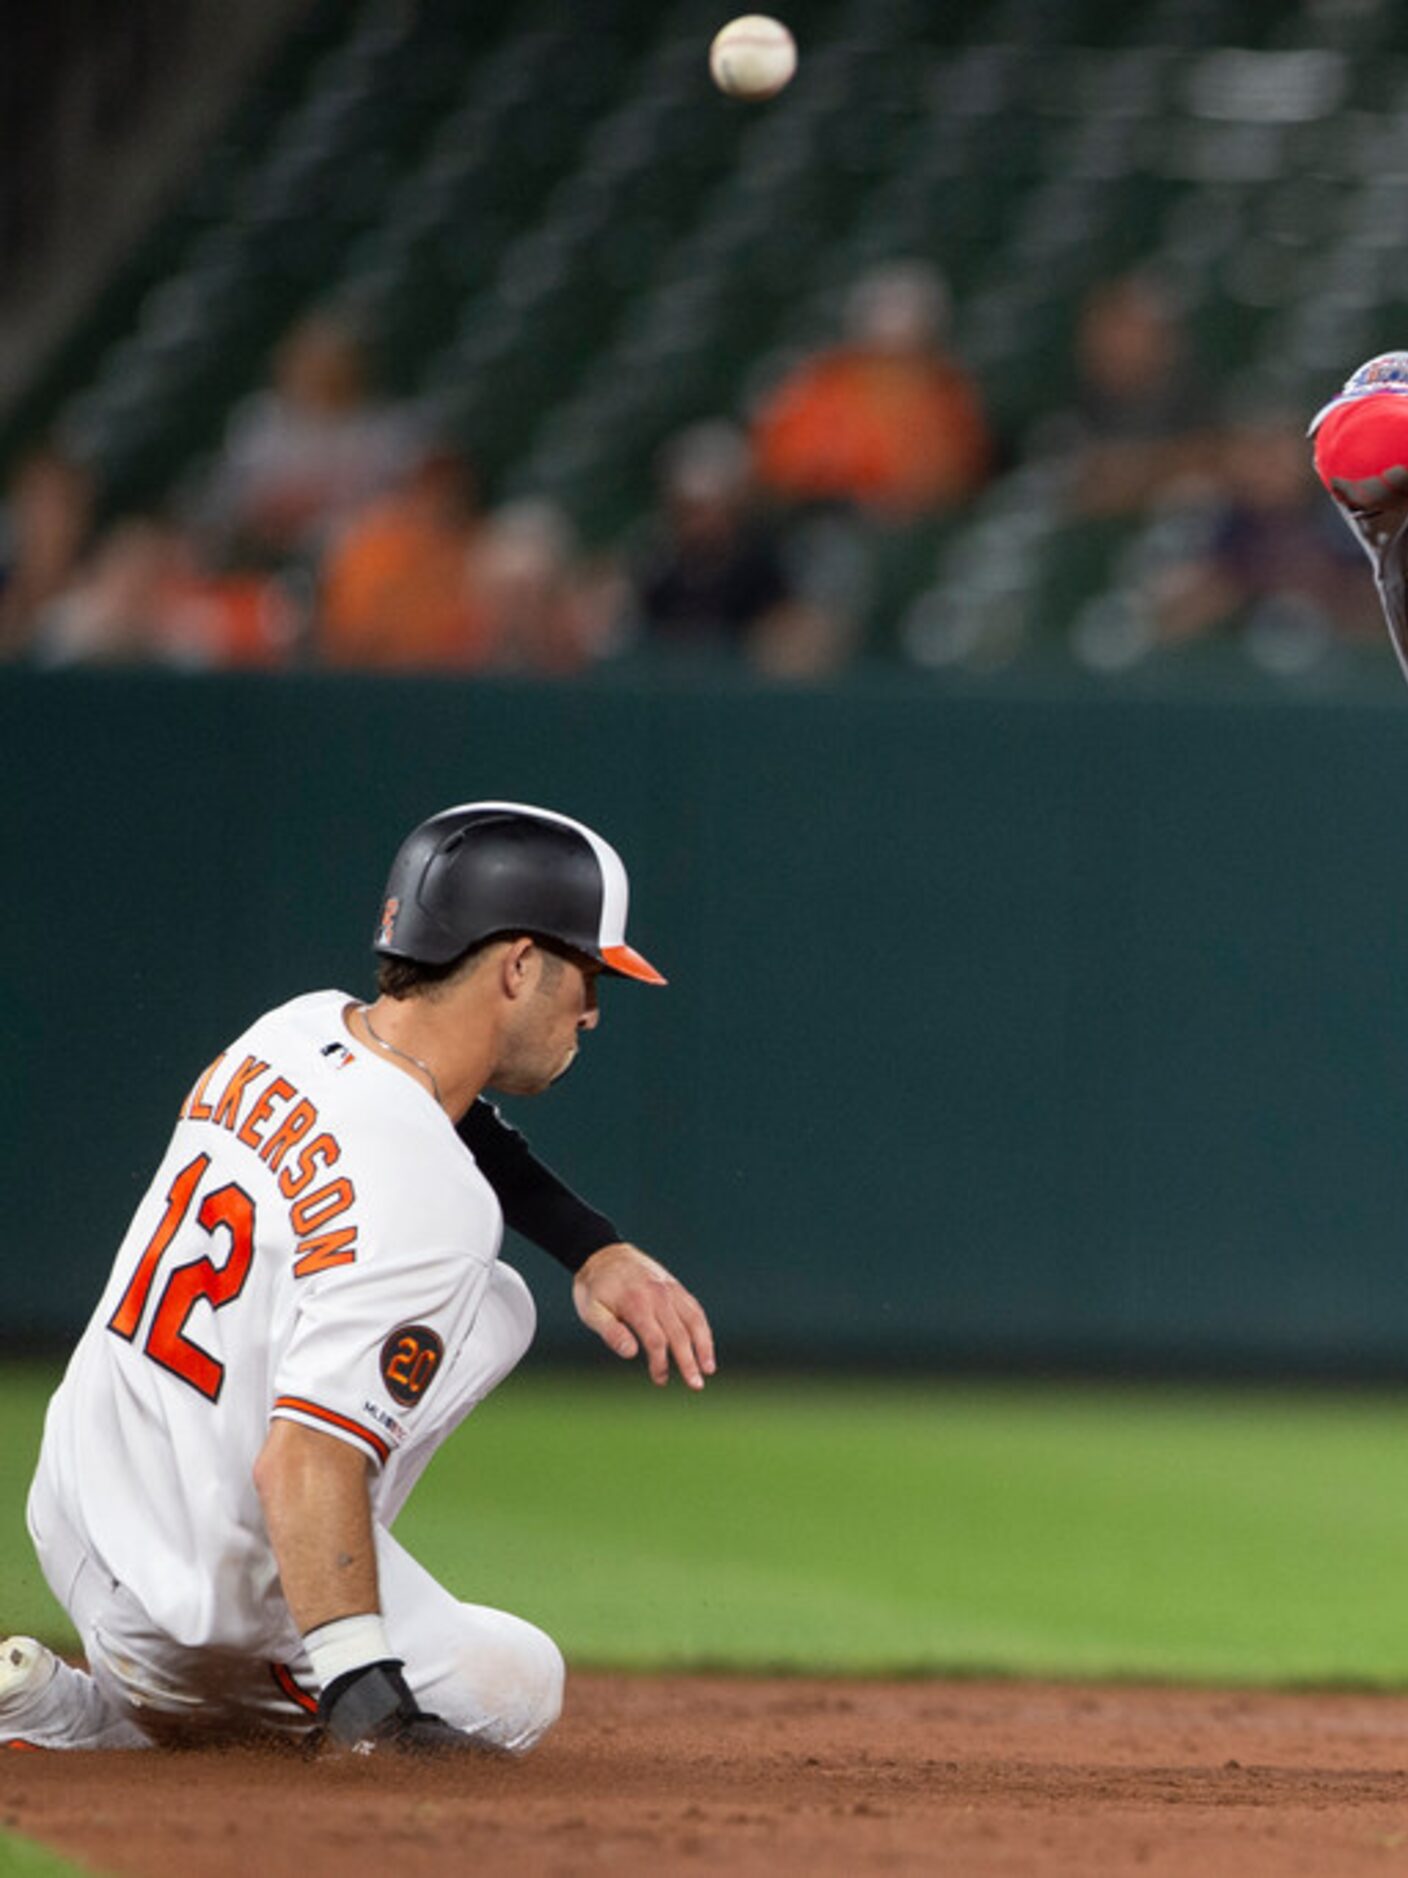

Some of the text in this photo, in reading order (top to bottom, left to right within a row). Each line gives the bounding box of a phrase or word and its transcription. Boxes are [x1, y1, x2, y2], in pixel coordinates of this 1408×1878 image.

[108, 1152, 256, 1404] 12
[179, 1053, 358, 1279] LKERSON
[387, 1336, 436, 1393] 20
